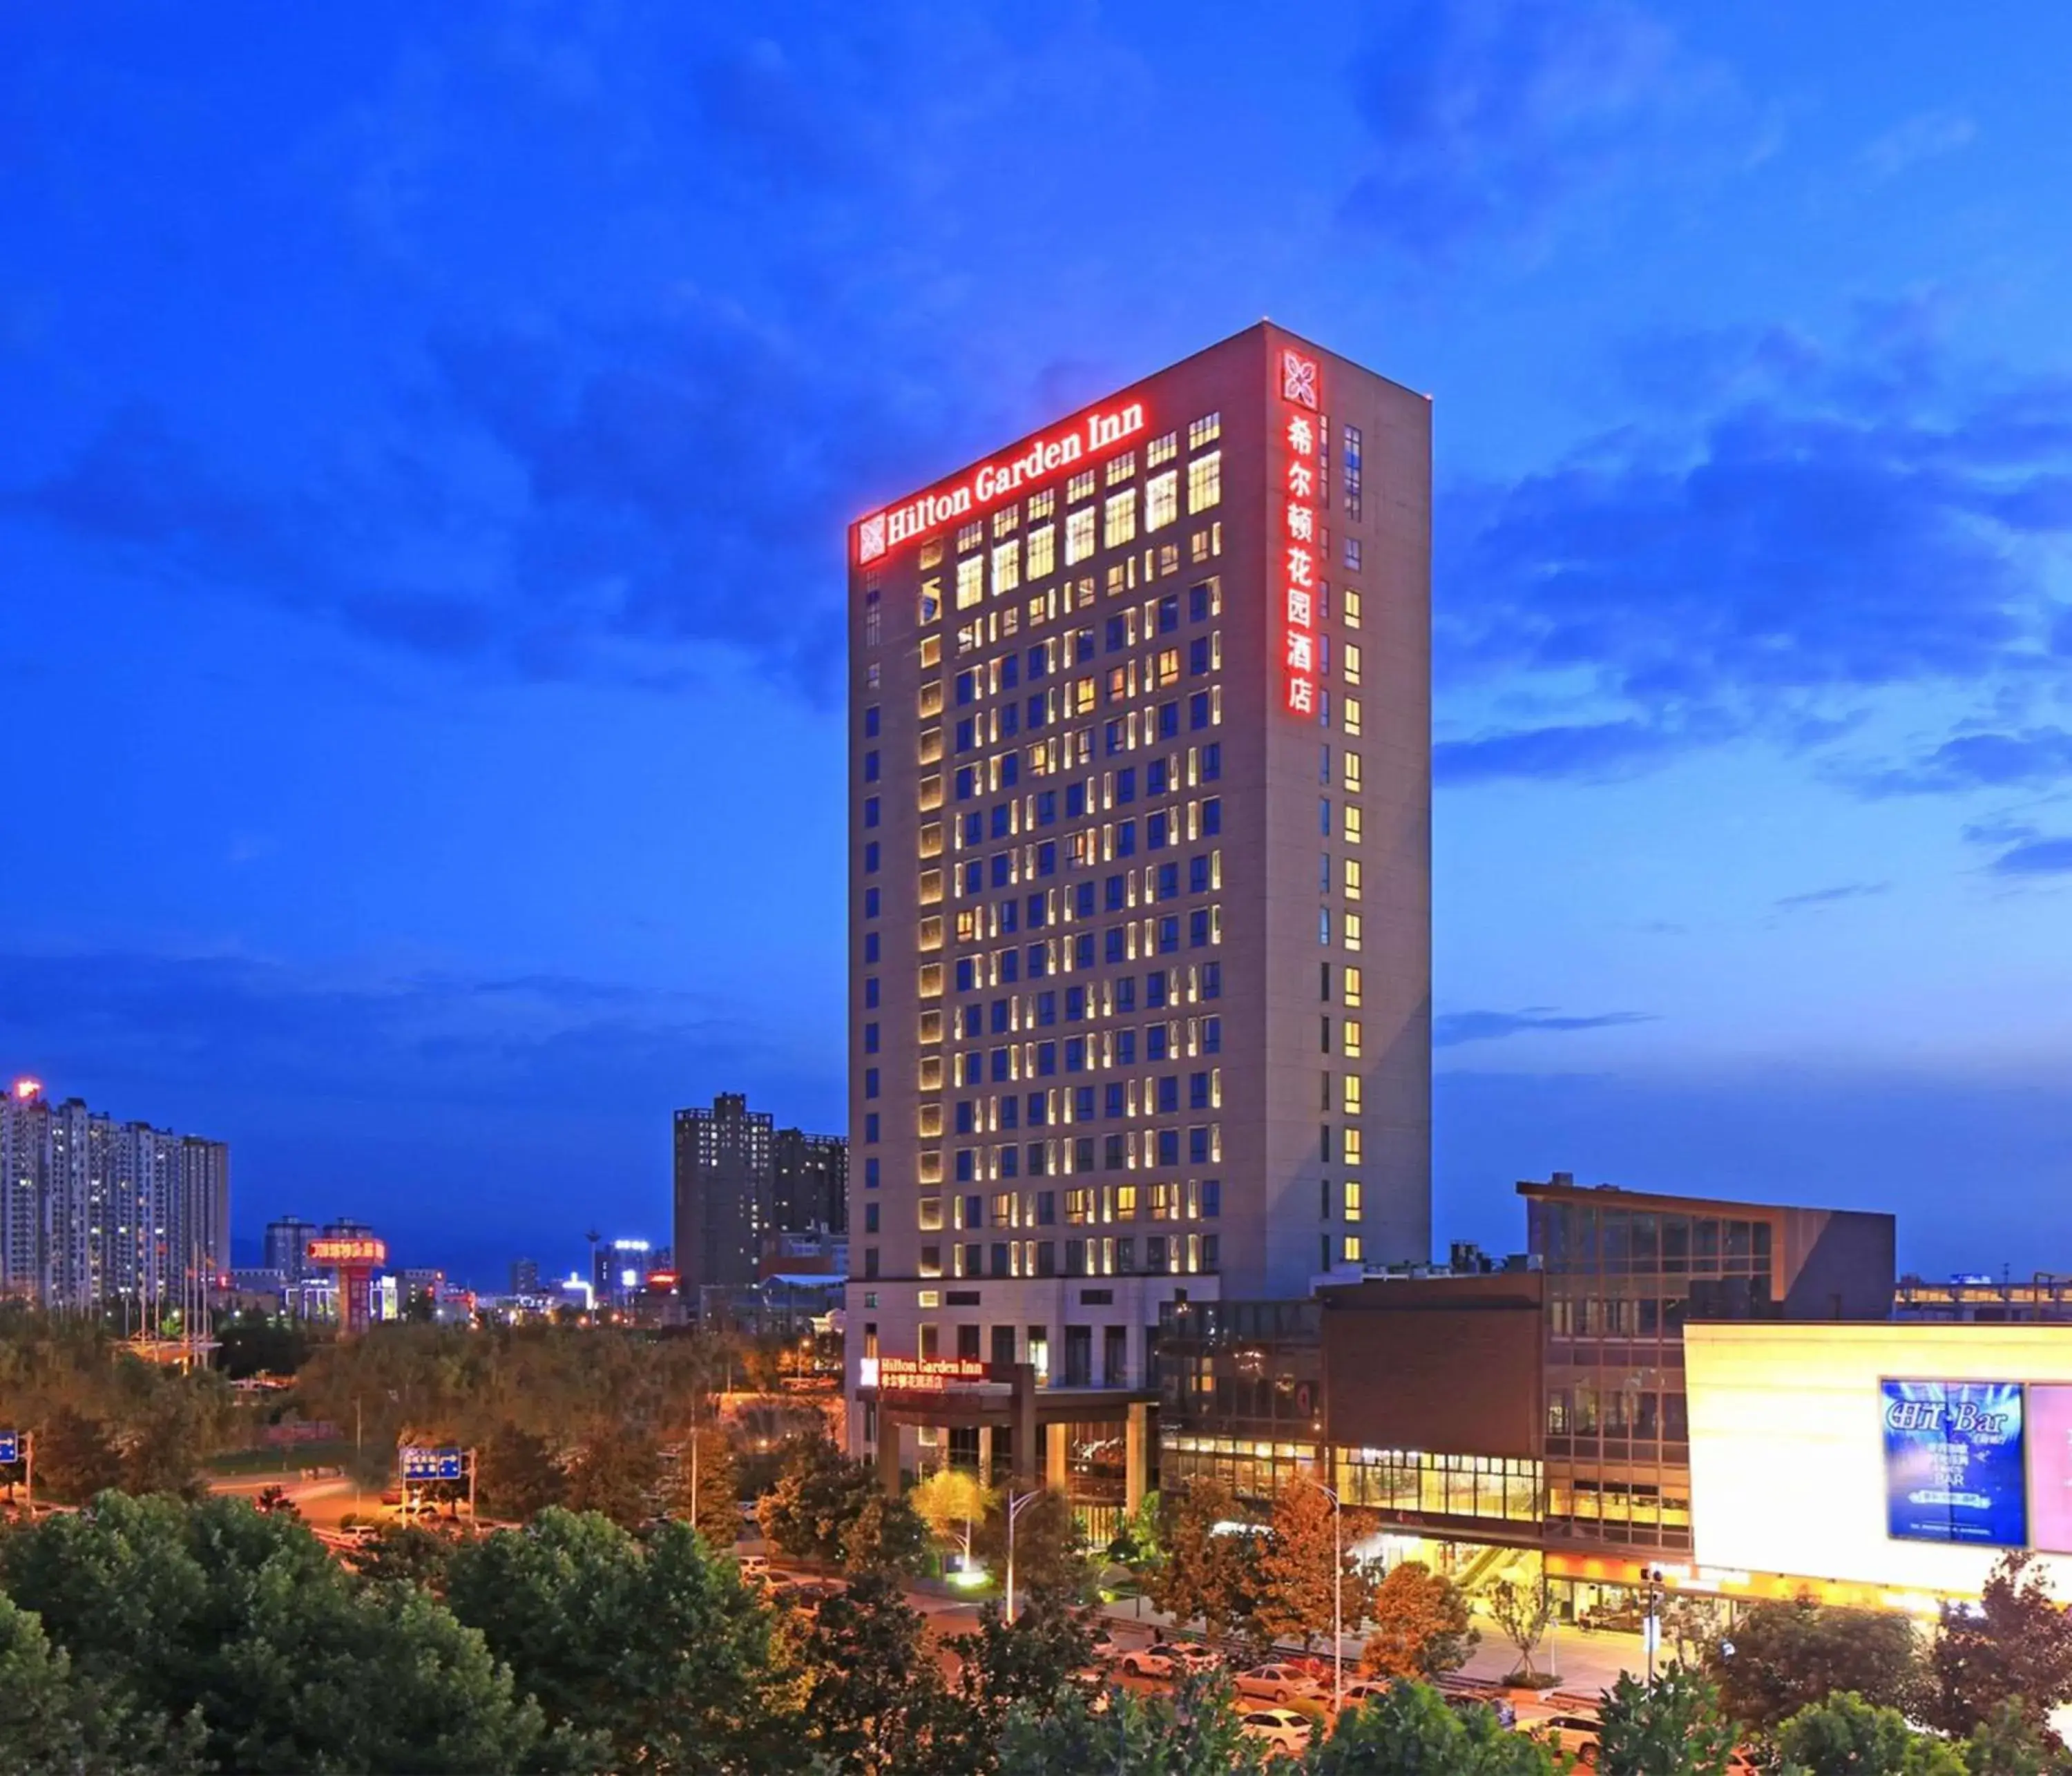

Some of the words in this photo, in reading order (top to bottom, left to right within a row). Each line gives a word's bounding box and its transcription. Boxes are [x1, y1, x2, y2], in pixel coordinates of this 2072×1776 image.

[887, 486, 972, 546] Hilton
[975, 433, 1082, 502] Garden
[1088, 403, 1144, 452] Inn
[1287, 416, 1313, 714] 希尔顿花园酒店
[881, 1358, 917, 1373] Hilton
[919, 1358, 959, 1374] Garden
[961, 1359, 983, 1375] Inn
